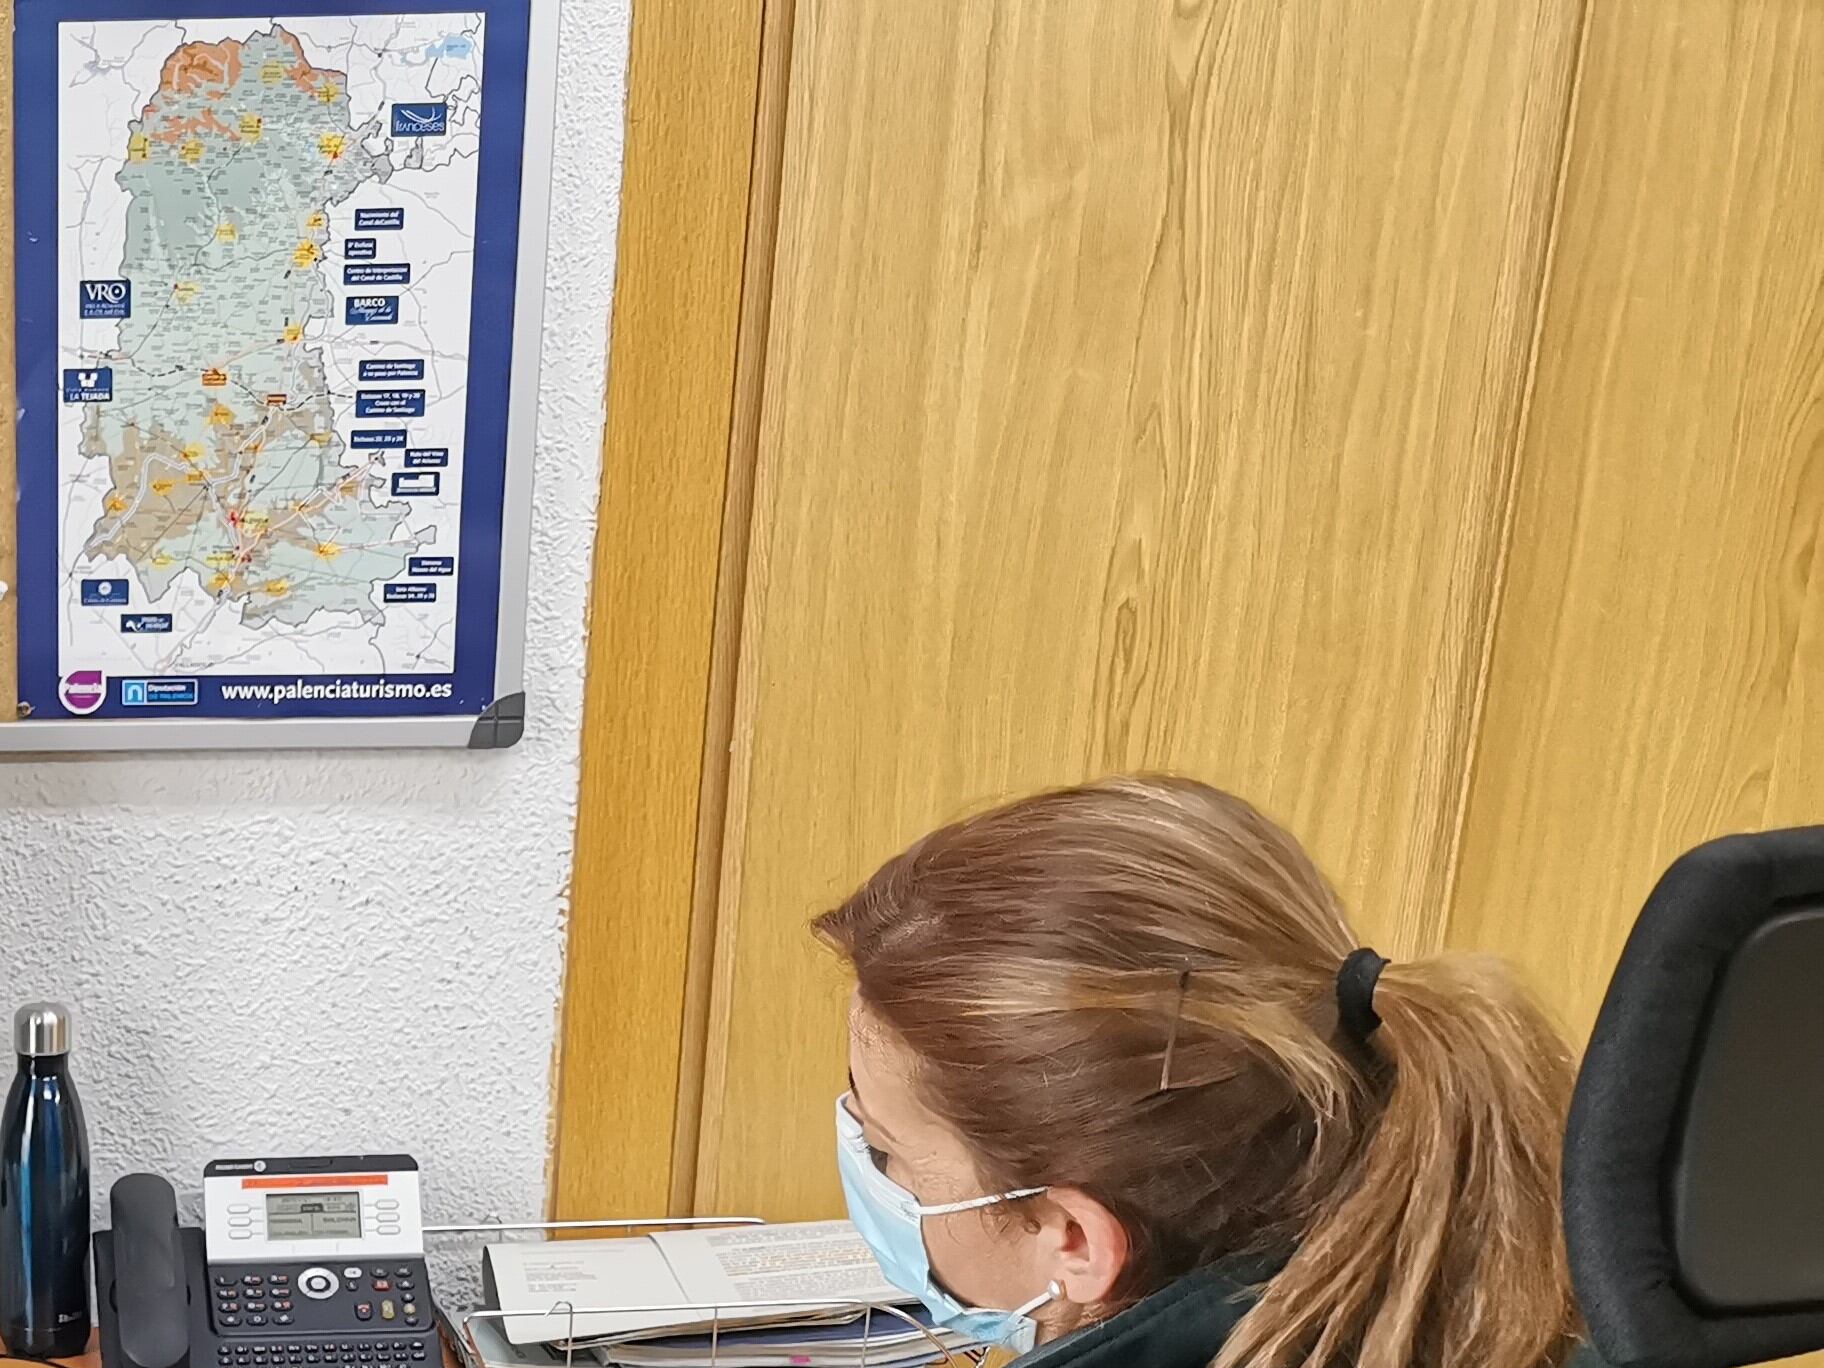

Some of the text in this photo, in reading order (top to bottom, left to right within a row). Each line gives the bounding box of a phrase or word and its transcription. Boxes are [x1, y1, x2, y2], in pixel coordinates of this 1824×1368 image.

[86, 284, 126, 303] VRO
[354, 298, 385, 307] BARCO
[222, 679, 452, 704] www.palenciaturismo.es
